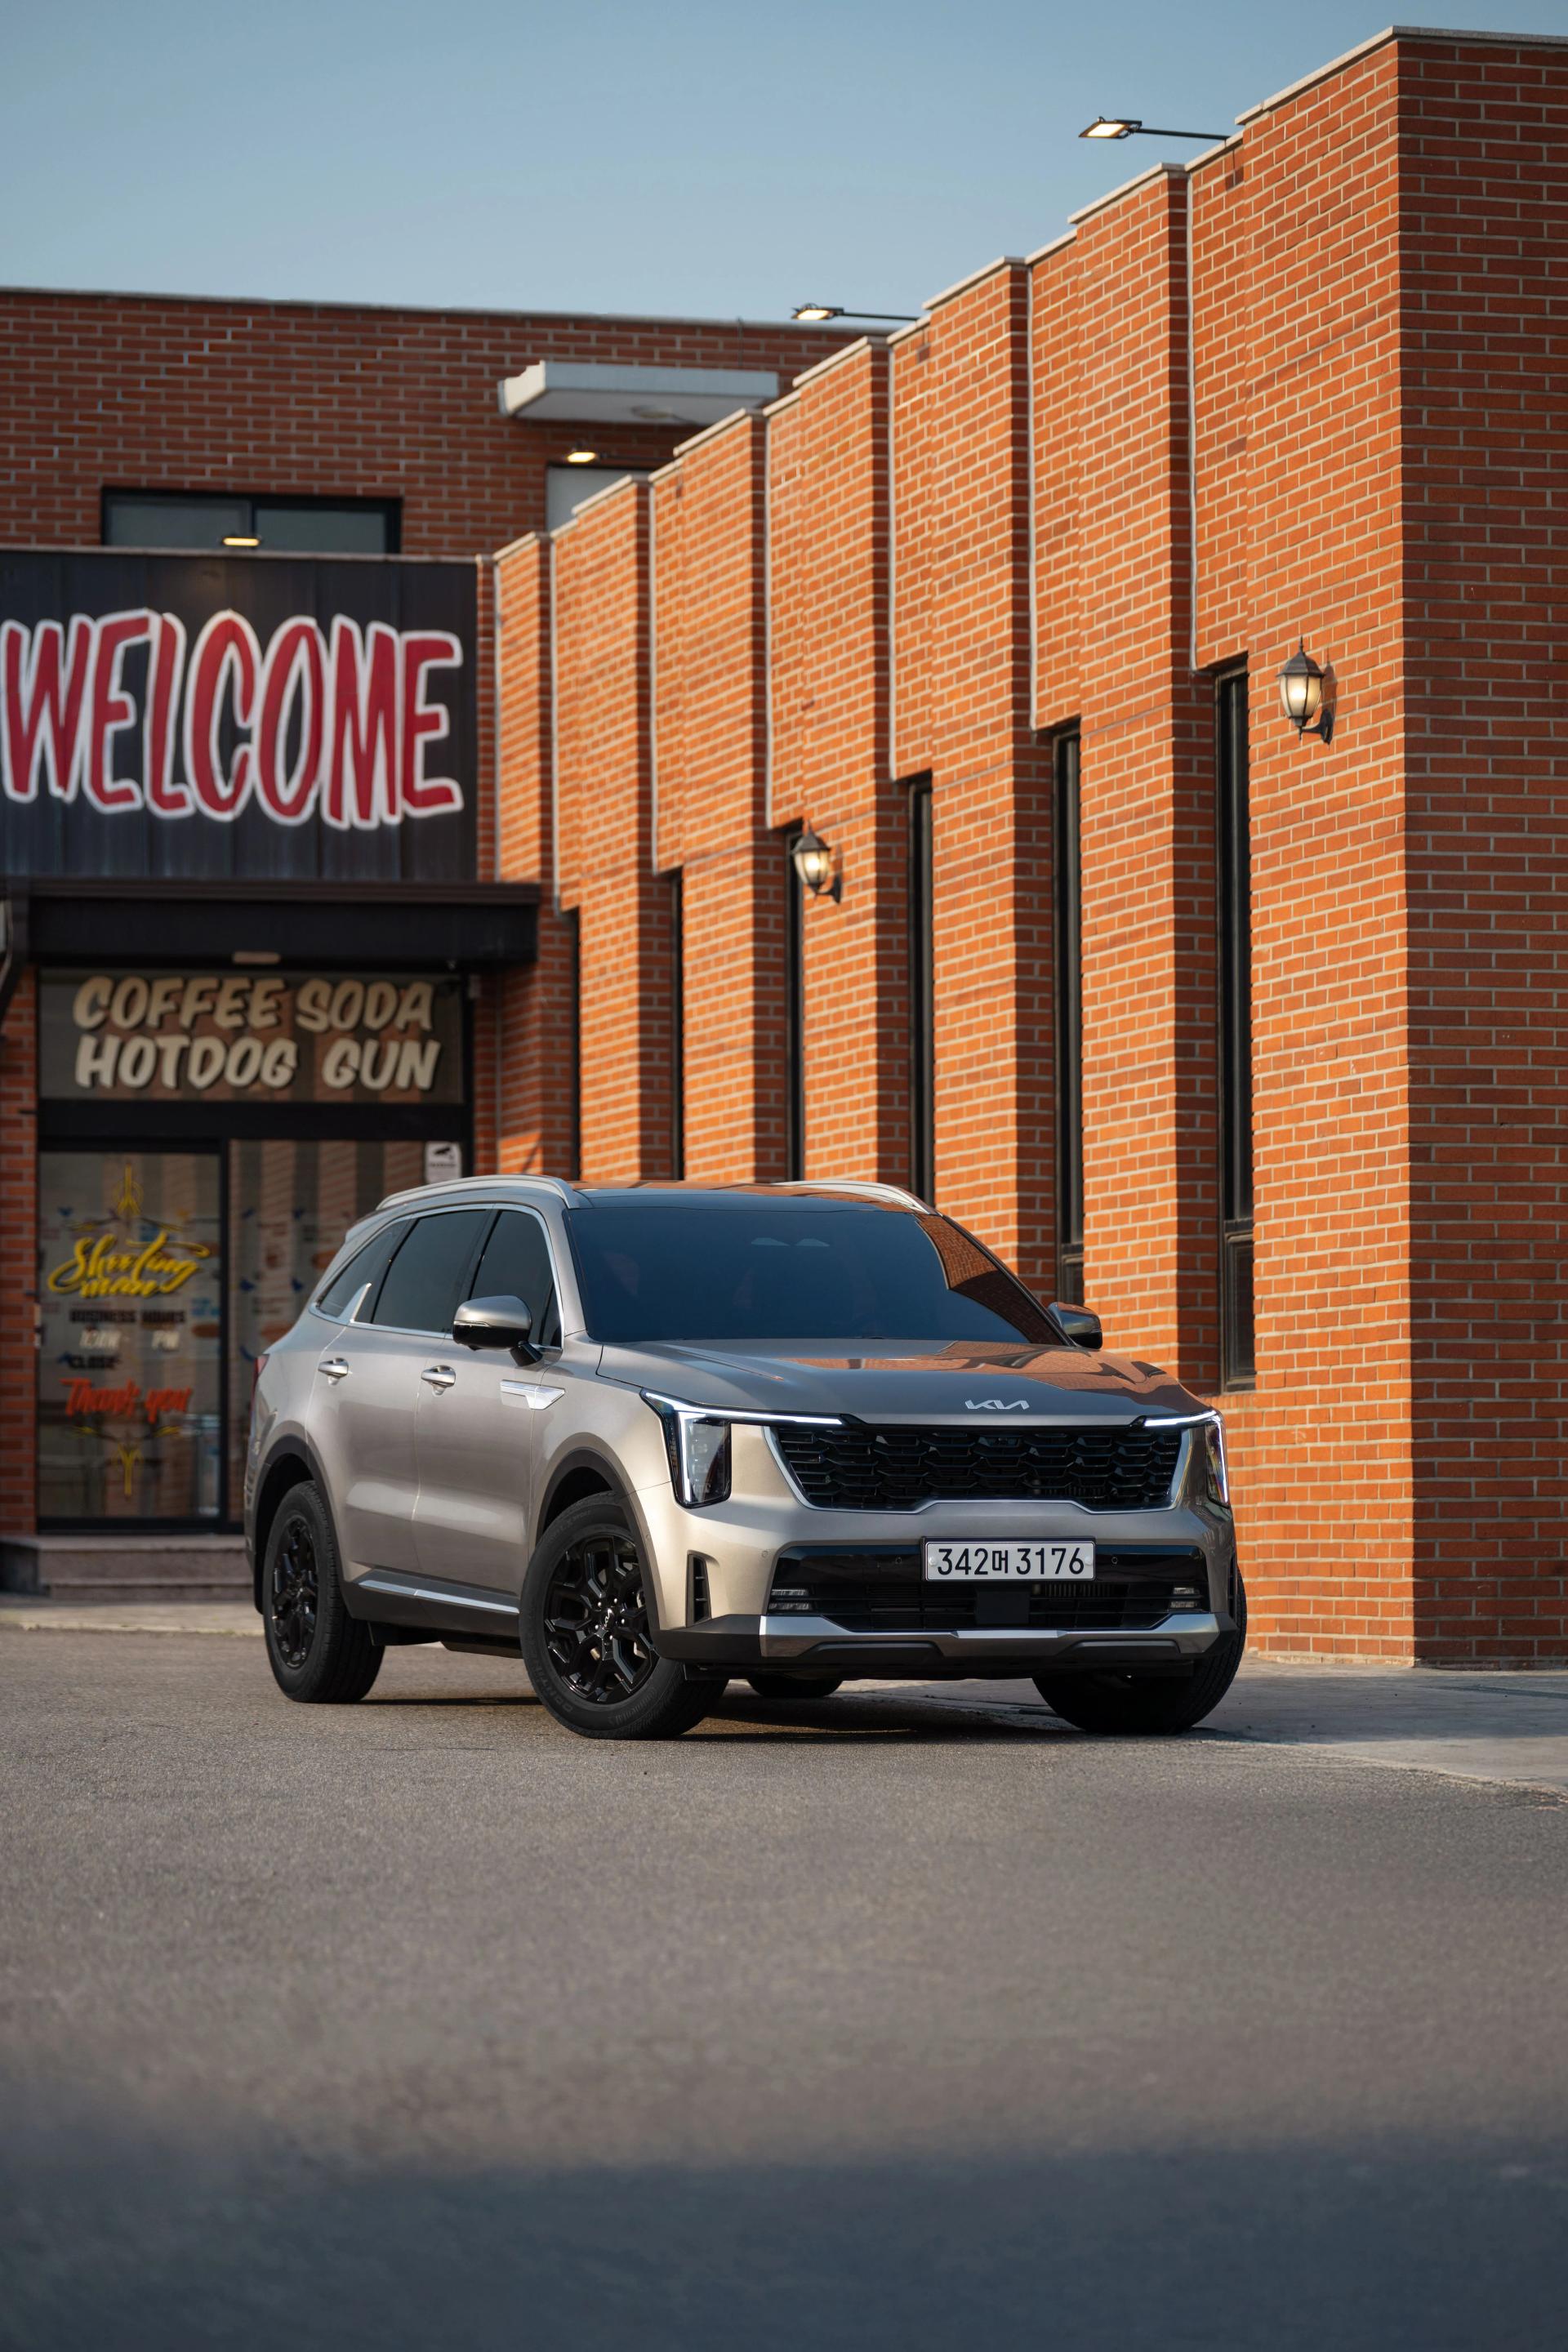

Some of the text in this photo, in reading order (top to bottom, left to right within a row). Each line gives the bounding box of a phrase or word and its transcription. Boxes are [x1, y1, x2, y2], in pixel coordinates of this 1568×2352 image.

[0, 607, 464, 830] WELCOME
[72, 976, 434, 1032] COFFEE SODA
[74, 1035, 441, 1091] HOTDOG GUN
[59, 1377, 193, 1423] Thank you
